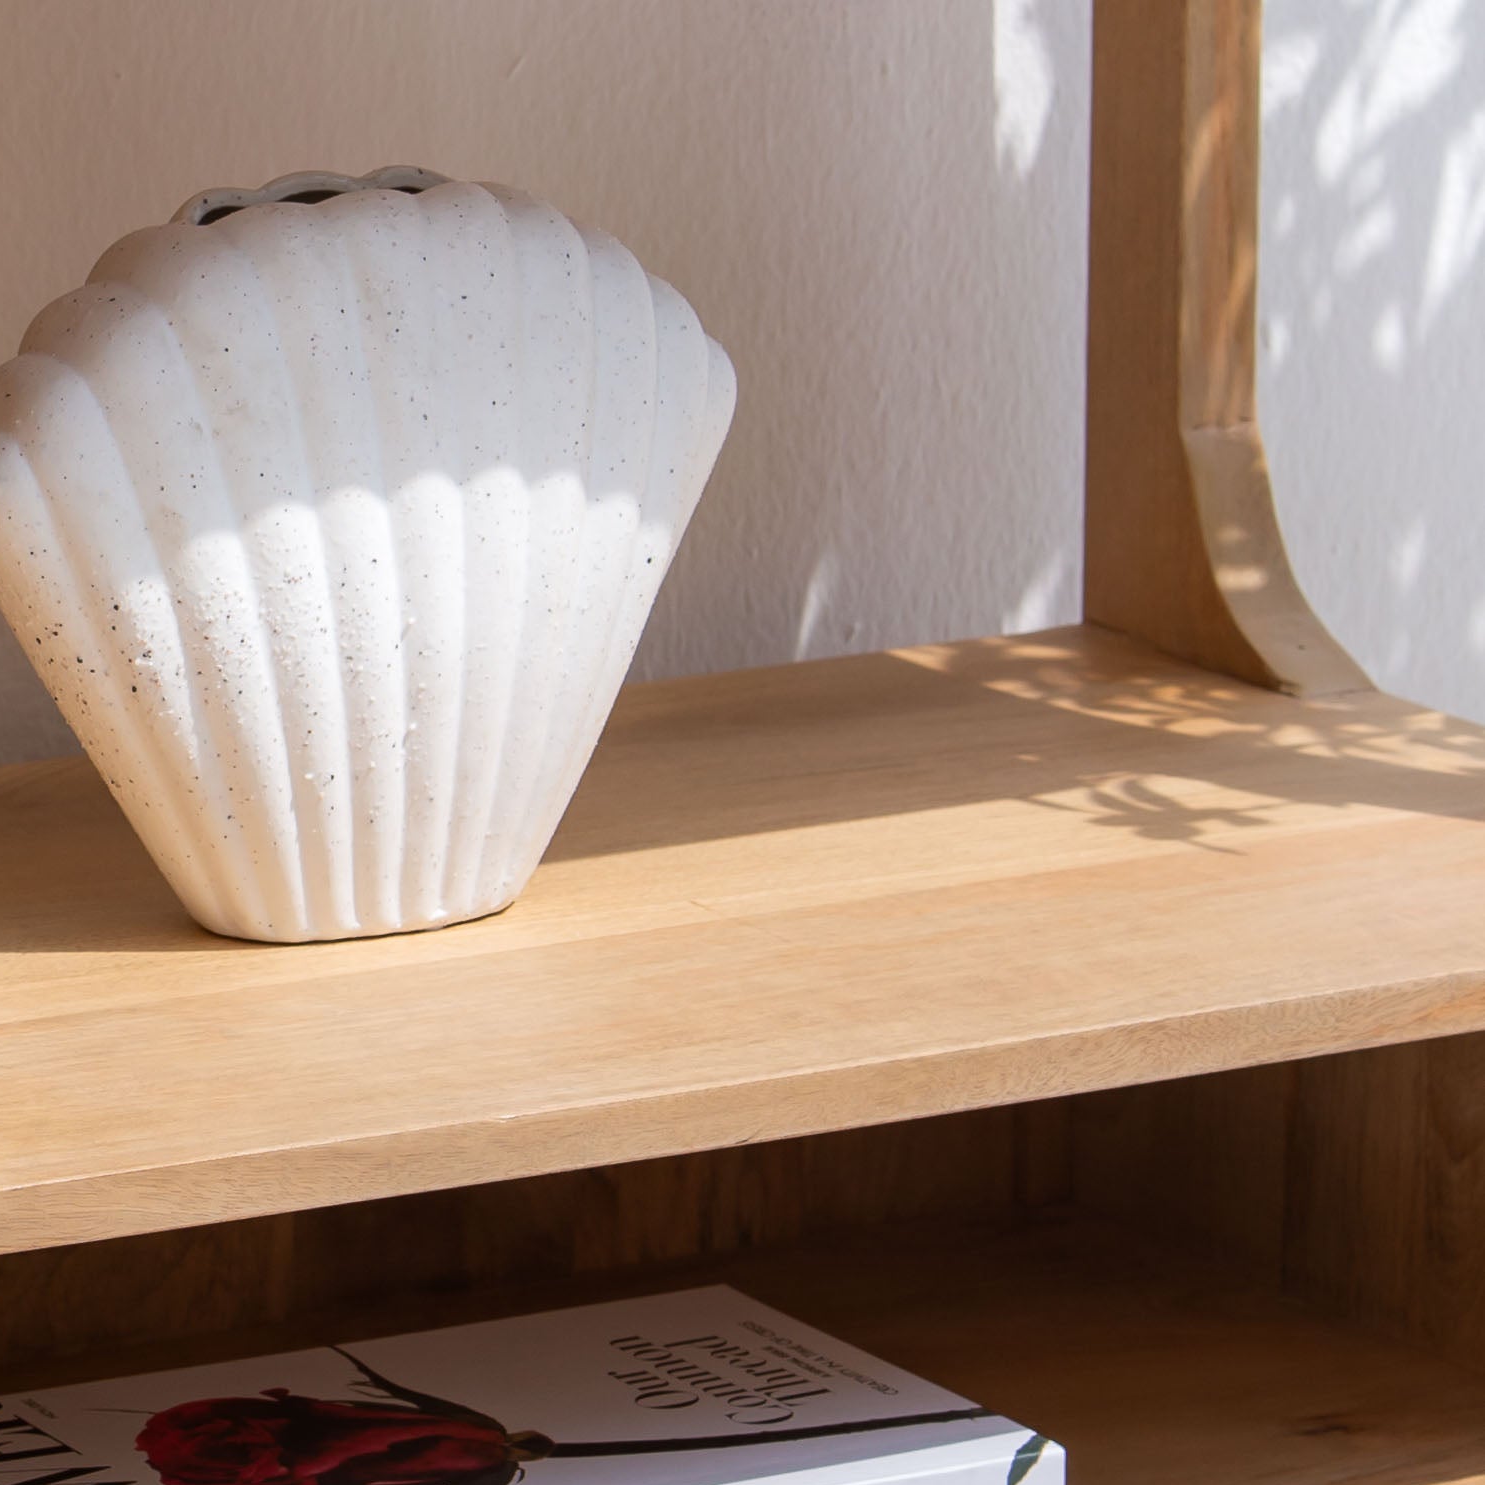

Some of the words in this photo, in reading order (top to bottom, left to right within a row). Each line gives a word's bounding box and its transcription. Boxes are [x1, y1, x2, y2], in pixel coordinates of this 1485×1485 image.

[608, 1371, 699, 1409] Our
[609, 1336, 794, 1424] Common
[663, 1335, 831, 1406] Thread
